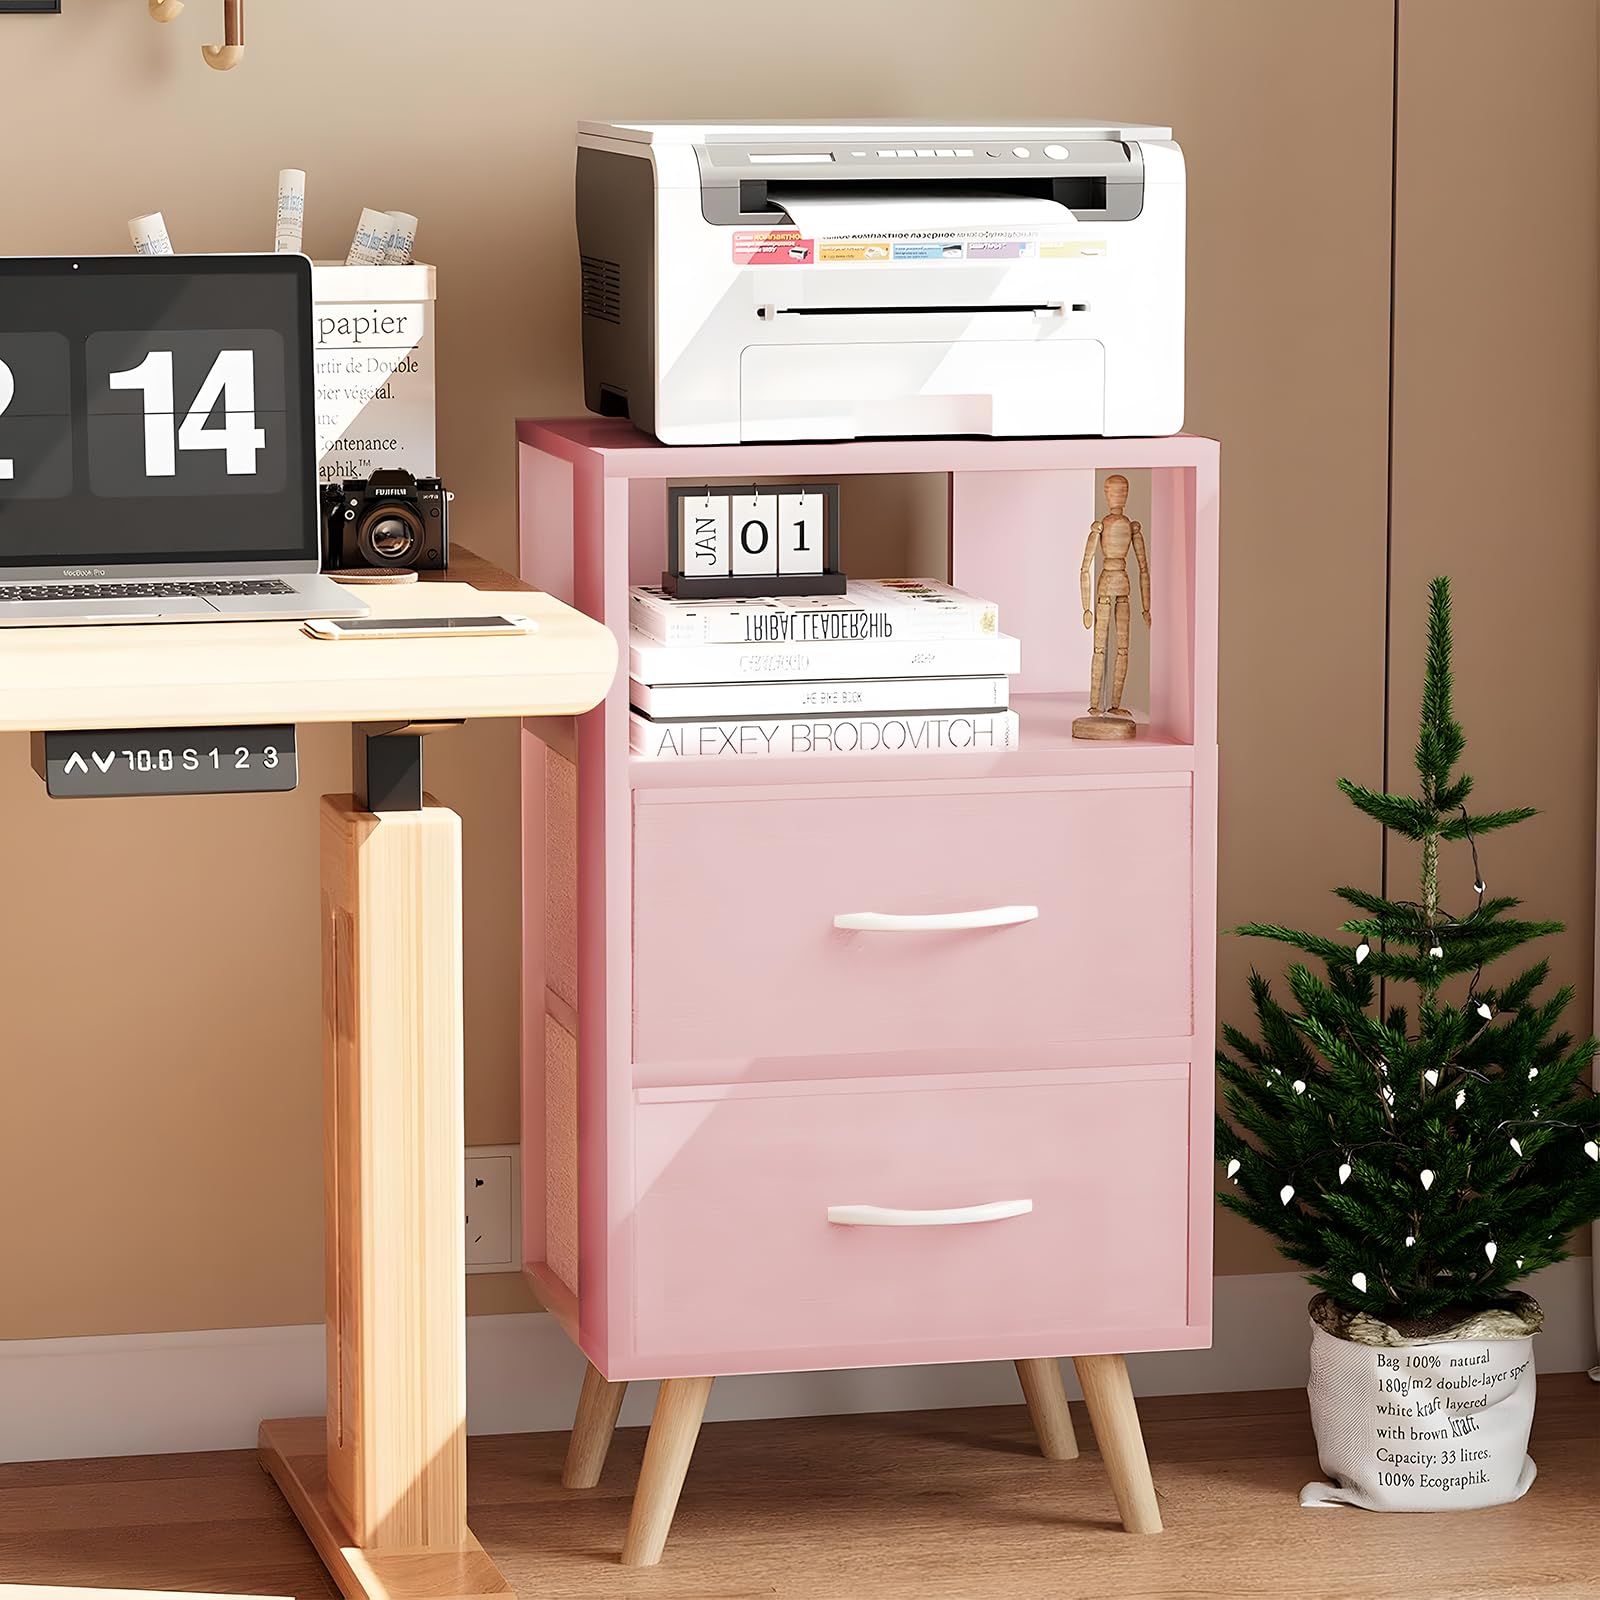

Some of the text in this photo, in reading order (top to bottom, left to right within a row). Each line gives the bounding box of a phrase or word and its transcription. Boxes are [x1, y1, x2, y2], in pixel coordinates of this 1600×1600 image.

[317, 309, 407, 344] papier
[345, 356, 363, 374] de
[109, 350, 265, 476] 14
[375, 488, 407, 496] FUJIFILM
[695, 518, 717, 566] JAN
[656, 724, 779, 757] ALEXEY
[791, 717, 995, 752] BRODOVITCH
[121, 746, 280, 771] 70.0 S 1 2 3
[1376, 1348, 1490, 1371] Bag 100% natural
[1378, 1375, 1433, 1397] 180g/m2
[1436, 1371, 1508, 1390] double-layer
[1376, 1393, 1488, 1417] white kraft layered
[1376, 1425, 1406, 1440] with
[1410, 1426, 1449, 1441] brown
[1376, 1447, 1492, 1468] Capacity: 33 litres.
[1378, 1469, 1490, 1491] 100% Ecographik.
